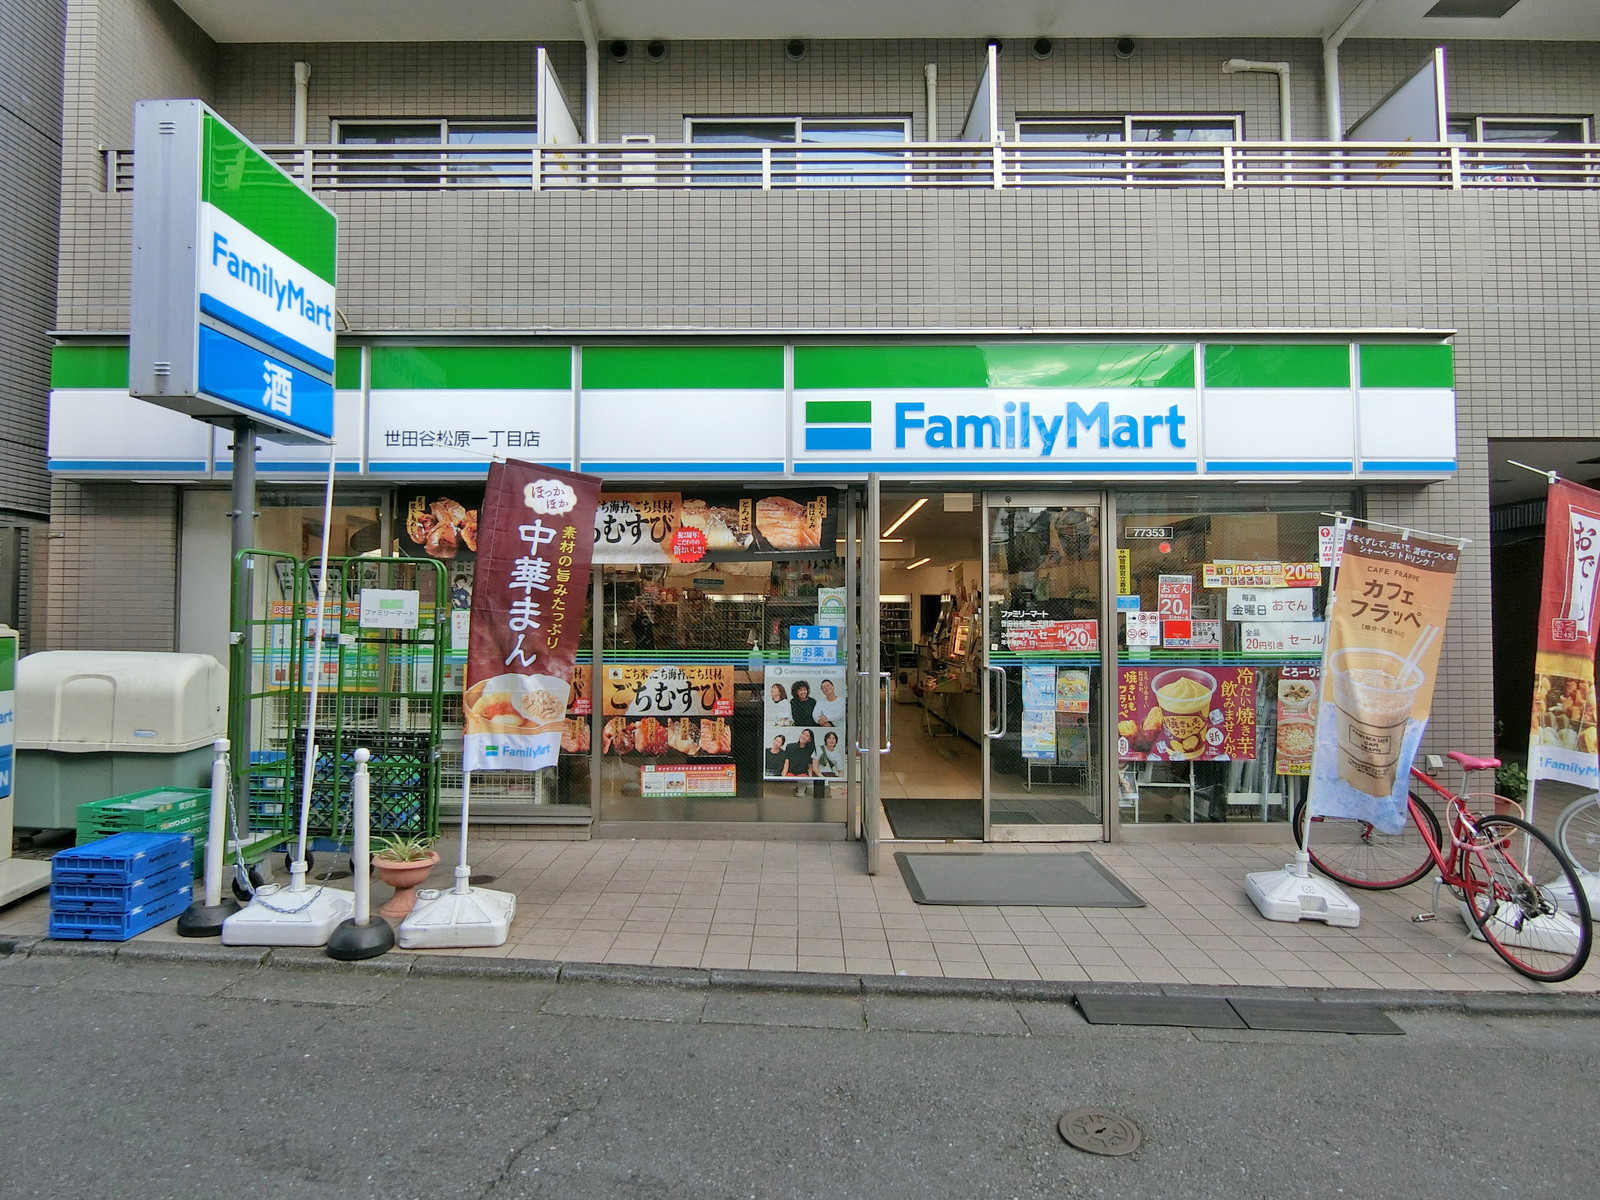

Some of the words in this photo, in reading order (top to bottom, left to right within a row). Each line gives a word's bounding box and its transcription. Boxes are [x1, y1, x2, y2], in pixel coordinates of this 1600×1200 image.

[212, 231, 332, 332] FamilyMart
[262, 359, 293, 416] 酒
[895, 401, 1187, 456] FamilyMart
[384, 430, 541, 448] 世田谷松原一丁目店
[531, 486, 565, 499] ほっか
[546, 499, 569, 510] ほか
[596, 499, 677, 514] ち海苔、ごち具材。
[594, 513, 675, 546] むすび
[1133, 528, 1166, 538] 77353
[504, 518, 558, 667] 中華まん
[546, 525, 578, 650] 素材の旨みたっぷり
[1160, 584, 1190, 595] おでん
[1363, 579, 1414, 606] カフェ
[1241, 594, 1257, 602] 毎週
[364, 608, 416, 616] ファミリーマート
[1000, 610, 1049, 619] ファミリーマート
[1232, 604, 1267, 616] 金曜日
[1272, 600, 1308, 611] おでん
[1350, 599, 1422, 628] フラッペ
[796, 627, 831, 639] お酒
[1245, 629, 1261, 637] 全品
[1246, 638, 1284, 650] 20円引き
[1289, 634, 1324, 646] セール
[802, 646, 825, 658] お薬
[624, 669, 725, 680] ごち米、ごち海苔、ごち具材。
[611, 681, 724, 712] ごちむすび
[1124, 670, 1138, 711] 焼きいも
[1118, 685, 1129, 718] フラッペ
[1221, 681, 1238, 758] 飲みませんか。
[1236, 667, 1255, 758] 冷たい焼き芋、
[1209, 731, 1220, 743] 新
[1545, 757, 1600, 777] FamilyM
